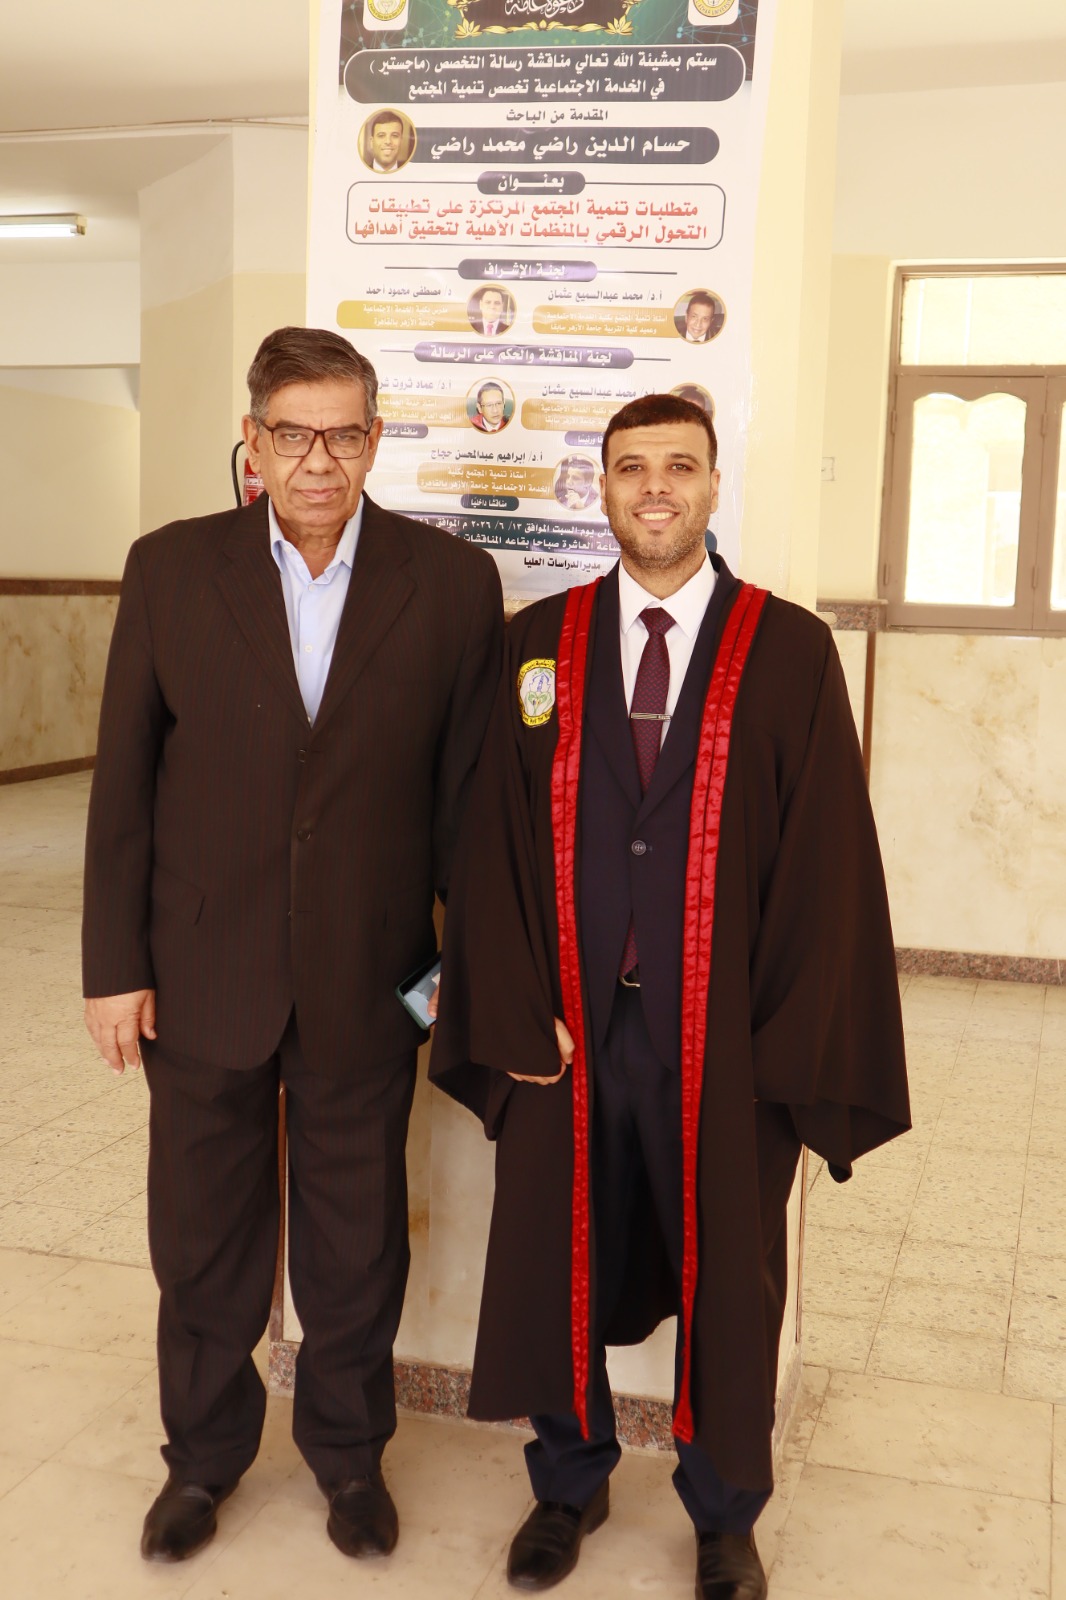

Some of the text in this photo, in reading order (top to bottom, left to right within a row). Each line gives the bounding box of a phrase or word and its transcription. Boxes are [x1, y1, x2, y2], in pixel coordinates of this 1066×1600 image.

[434, 54, 485, 73] التخصص
[489, 54, 523, 71] رسالة
[527, 52, 571, 69] مناقشة
[575, 52, 609, 74] تعالي
[613, 50, 634, 67] الله
[638, 50, 682, 72] بمشيئة
[686, 52, 718, 71] سيتم
[408, 77, 666, 100] في الخدمة الاجتماعية تخصص تنمية المجتمع
[506, 108, 608, 124] المقدمة من الباحث
[430, 135, 691, 160] حسام الدين راضي محمد راضي
[368, 198, 698, 221] متطلبات تنمية المجتمع المرتكزة على تطبيقات
[354, 218, 707, 245] التحول الرقمي بالمنظمات الأهلية لتحقيق أهدافها
[535, 263, 566, 279] لجنة
[388, 286, 410, 298] محمود
[547, 287, 572, 301] عثمان
[622, 290, 643, 301] محمد
[418, 318, 436, 328] جامعة
[430, 345, 613, 366] لجنة المناقشة والحكم على الرسالة
[392, 377, 413, 391] ثروت
[416, 380, 434, 390] عماد
[541, 383, 566, 397] عثمان
[615, 389, 636, 398] محمد
[382, 426, 399, 436] خارجي
[431, 447, 452, 460] حجاج
[497, 452, 526, 464] إبراهيم
[466, 469, 487, 480] المجتمع
[489, 469, 508, 480] تنمية
[470, 480, 489, 492] جامعة
[435, 517, 460, 529] الموافق
[524, 522, 550, 535] الموافق
[552, 525, 577, 536] السبت
[580, 528, 595, 538] يوم
[464, 533, 502, 545] المناقشات
[532, 537, 560, 549] صباحا
[562, 539, 594, 551] العاشرة
[523, 556, 545, 569] العليا
